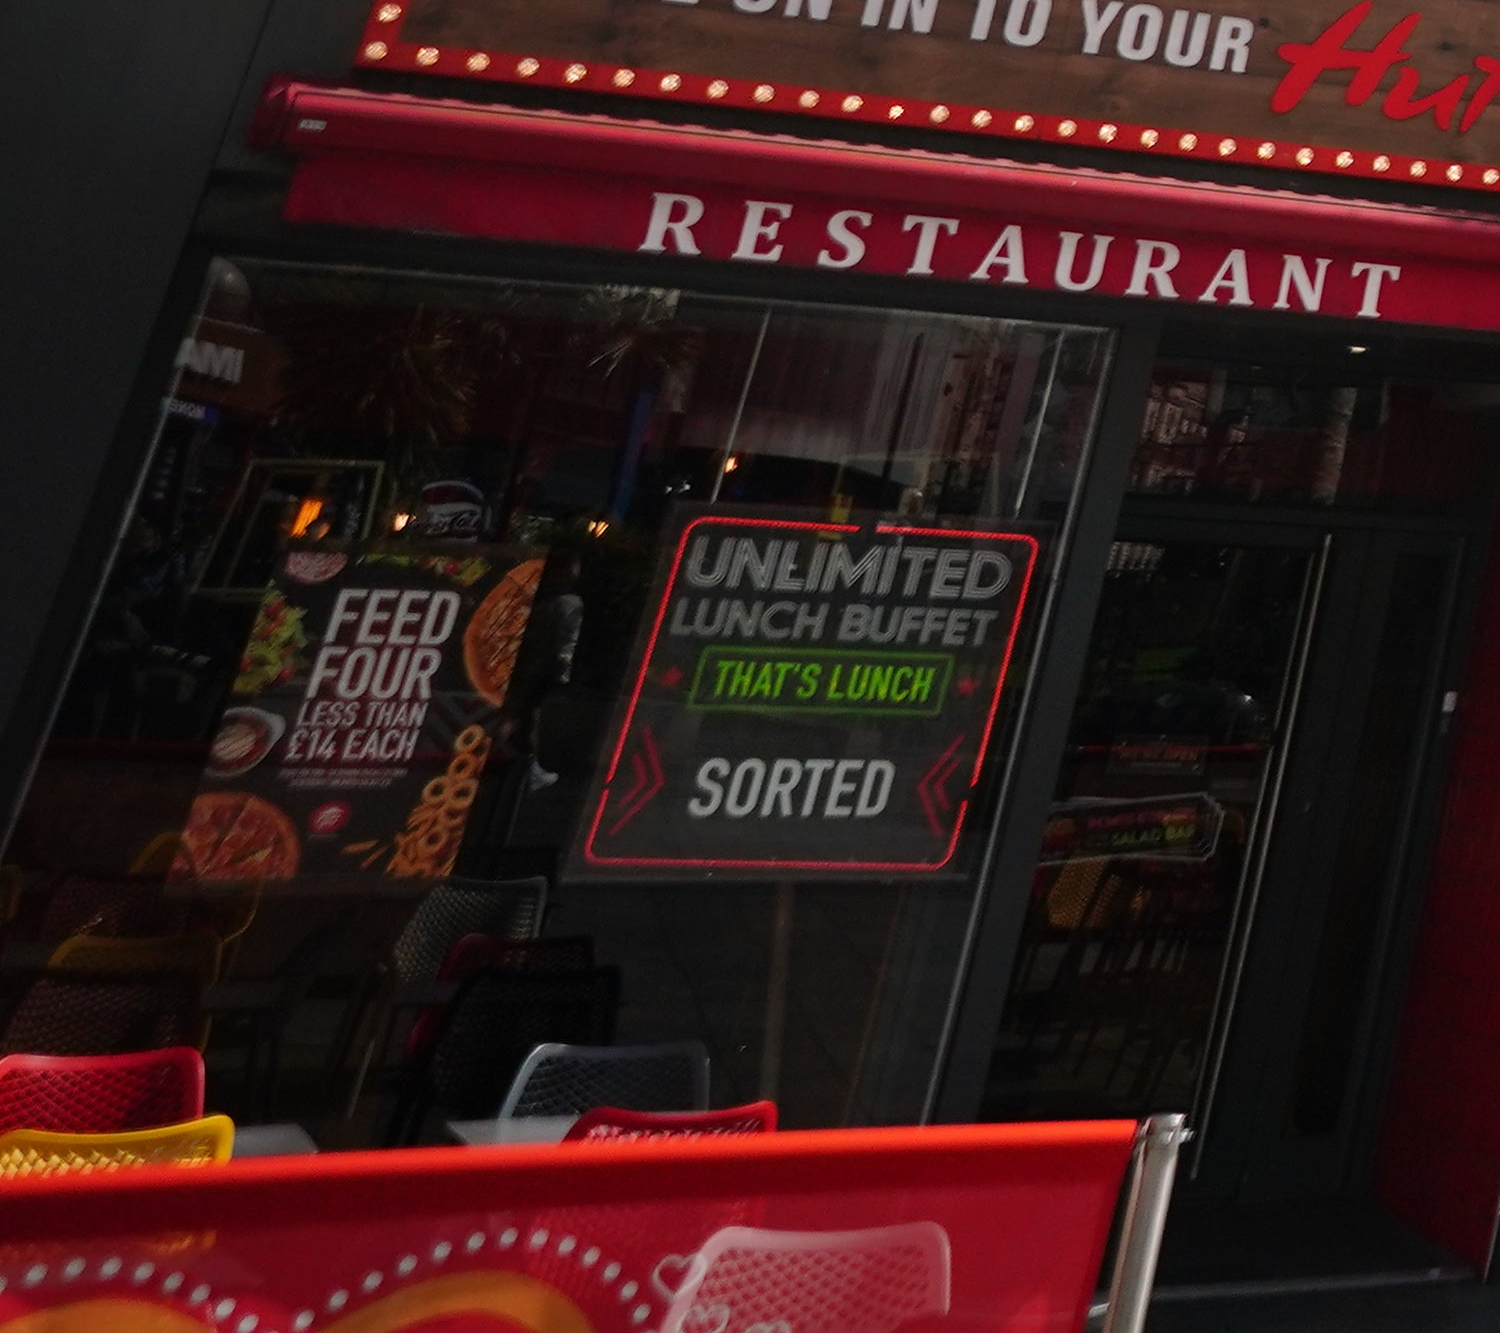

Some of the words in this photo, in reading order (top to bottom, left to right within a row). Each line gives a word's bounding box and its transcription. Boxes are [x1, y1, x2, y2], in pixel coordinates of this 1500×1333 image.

[638, 190, 1401, 320] RESTAURANT
[686, 535, 1013, 601] UNLIMITED
[324, 588, 464, 647] FEED
[671, 599, 833, 642] LUNCH
[837, 602, 999, 648] BUFFET
[305, 646, 444, 701] FOUR
[713, 660, 824, 700] THAT'S
[826, 664, 937, 703] LUNCH
[296, 701, 362, 728] LESS
[365, 701, 430, 729] THAN
[284, 728, 338, 761] £14
[342, 728, 421, 761] EACH
[688, 757, 897, 820] SORTED
